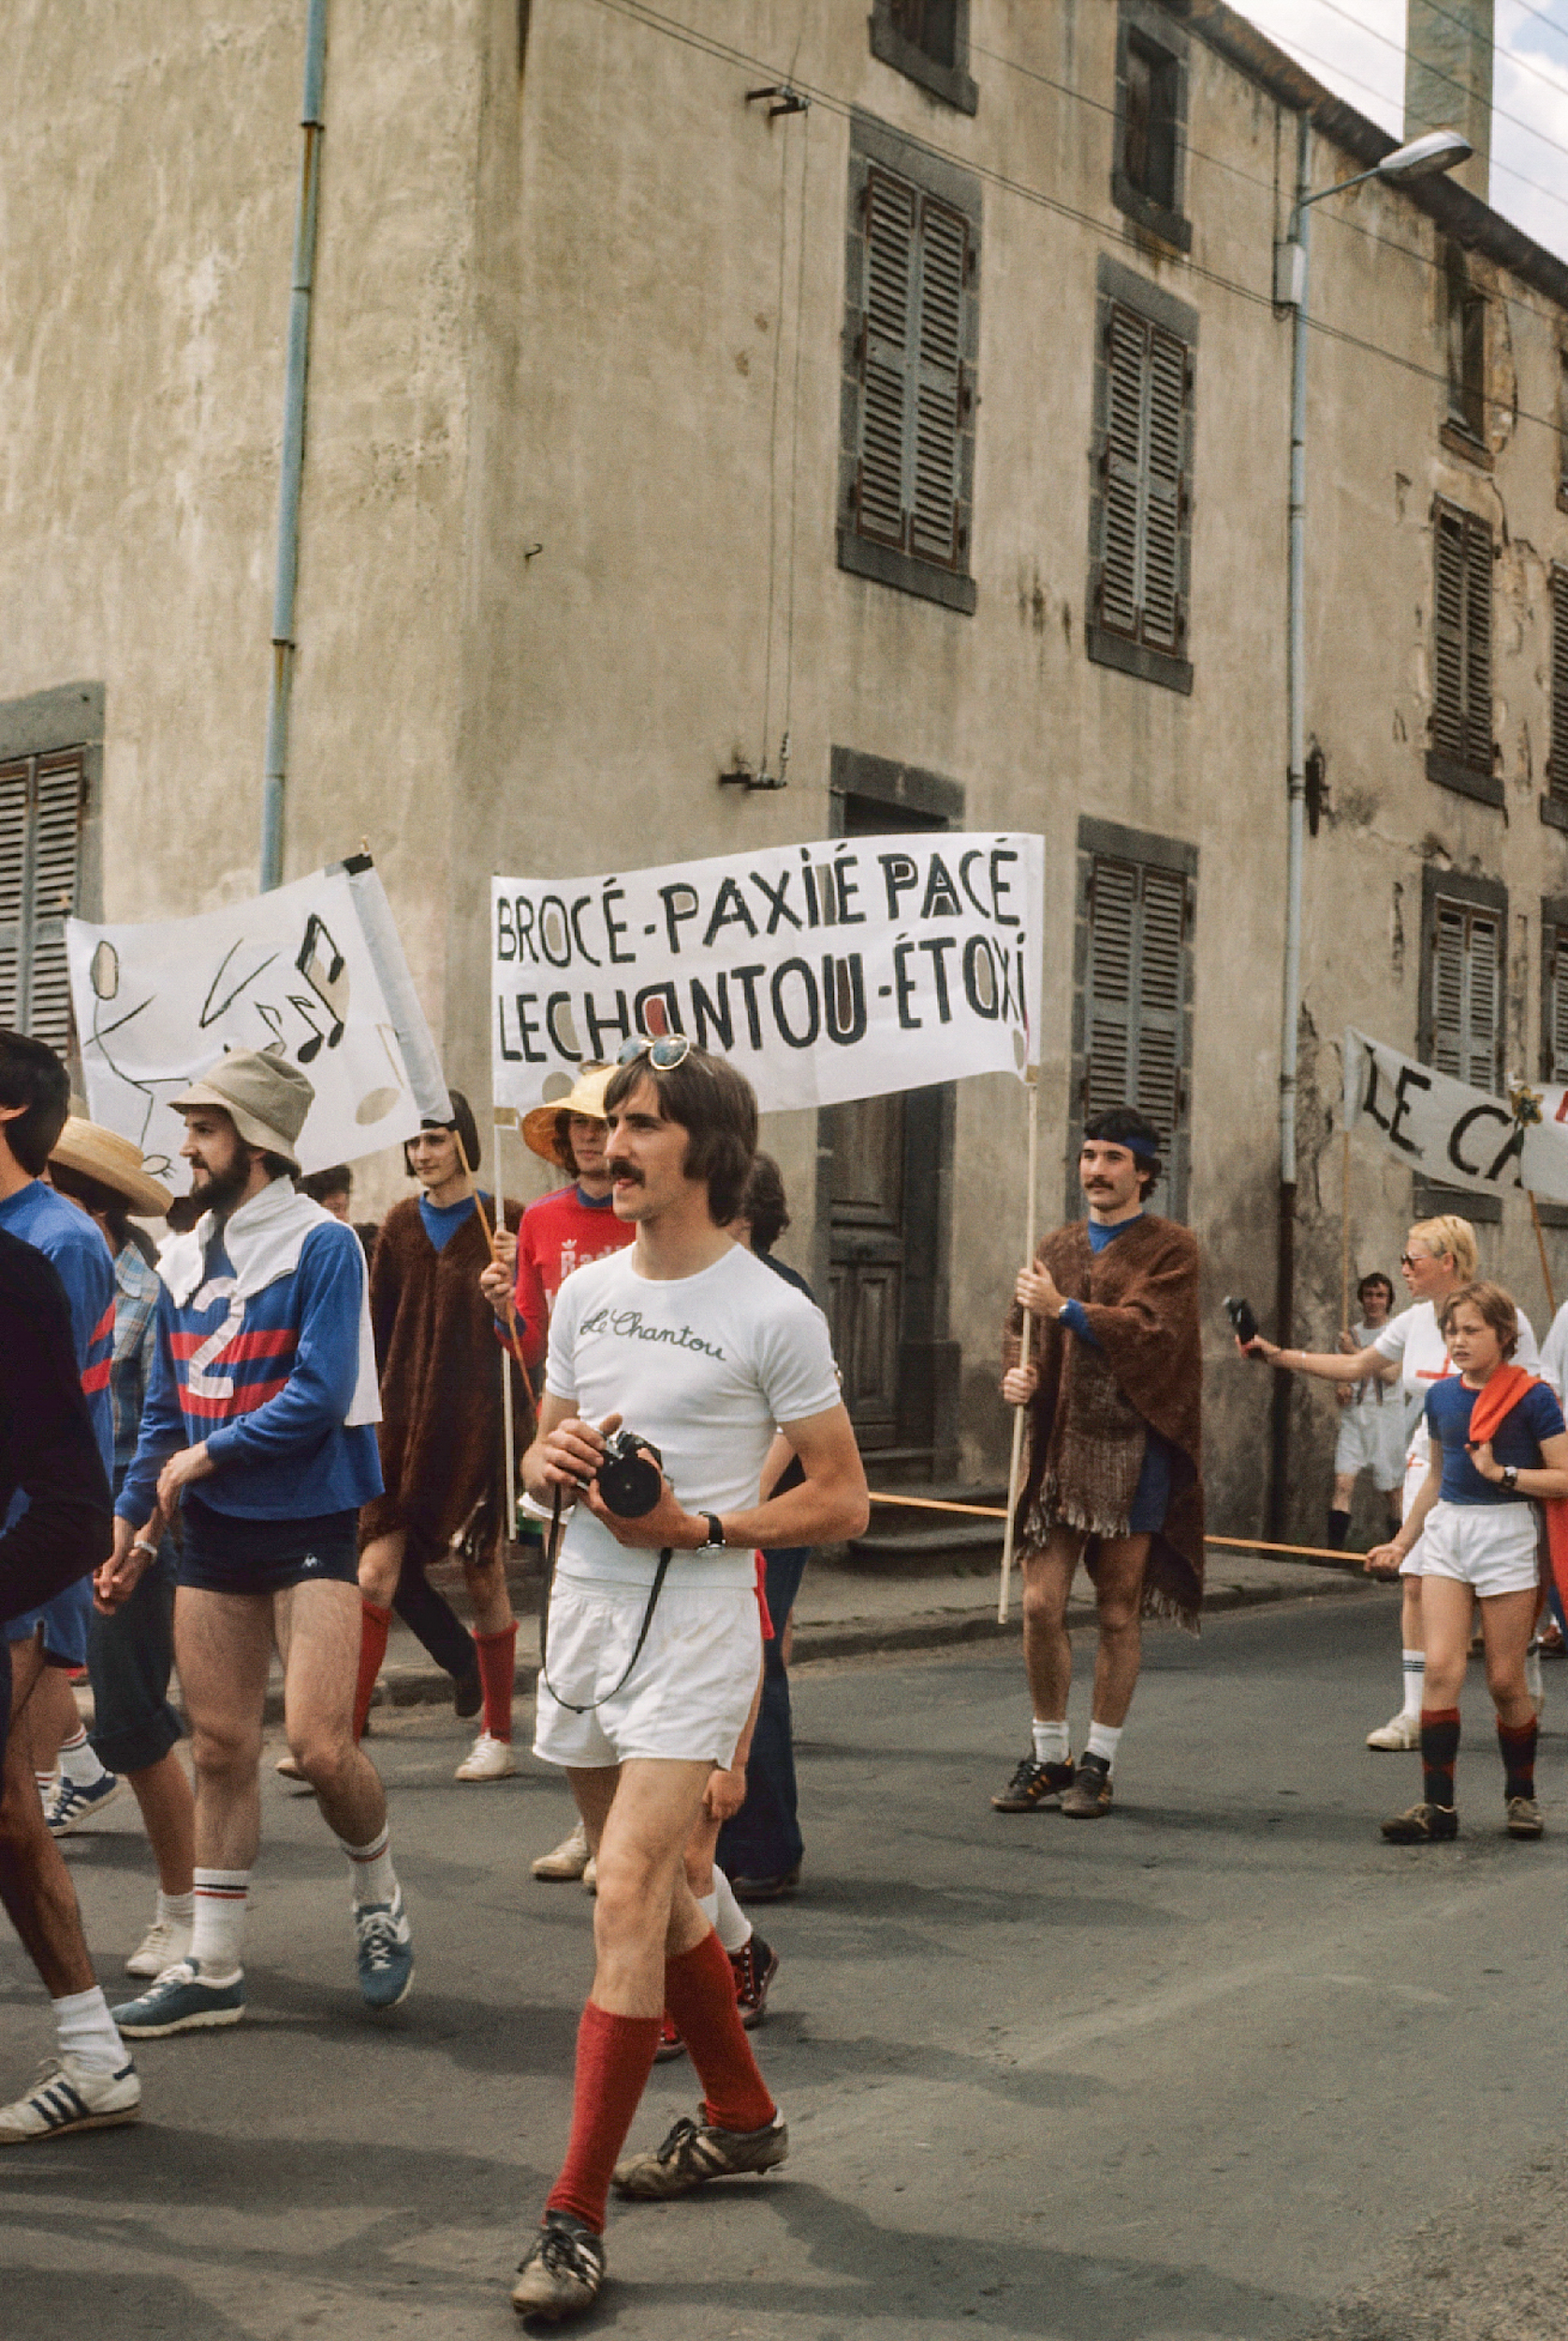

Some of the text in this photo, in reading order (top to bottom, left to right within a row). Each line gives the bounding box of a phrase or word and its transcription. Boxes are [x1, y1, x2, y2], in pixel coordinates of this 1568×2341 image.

[876, 837, 1020, 927] PACÉ
[1363, 1042, 1432, 1159] LE
[188, 1276, 245, 1399] 2
[579, 1308, 727, 1362] Le Chantou
